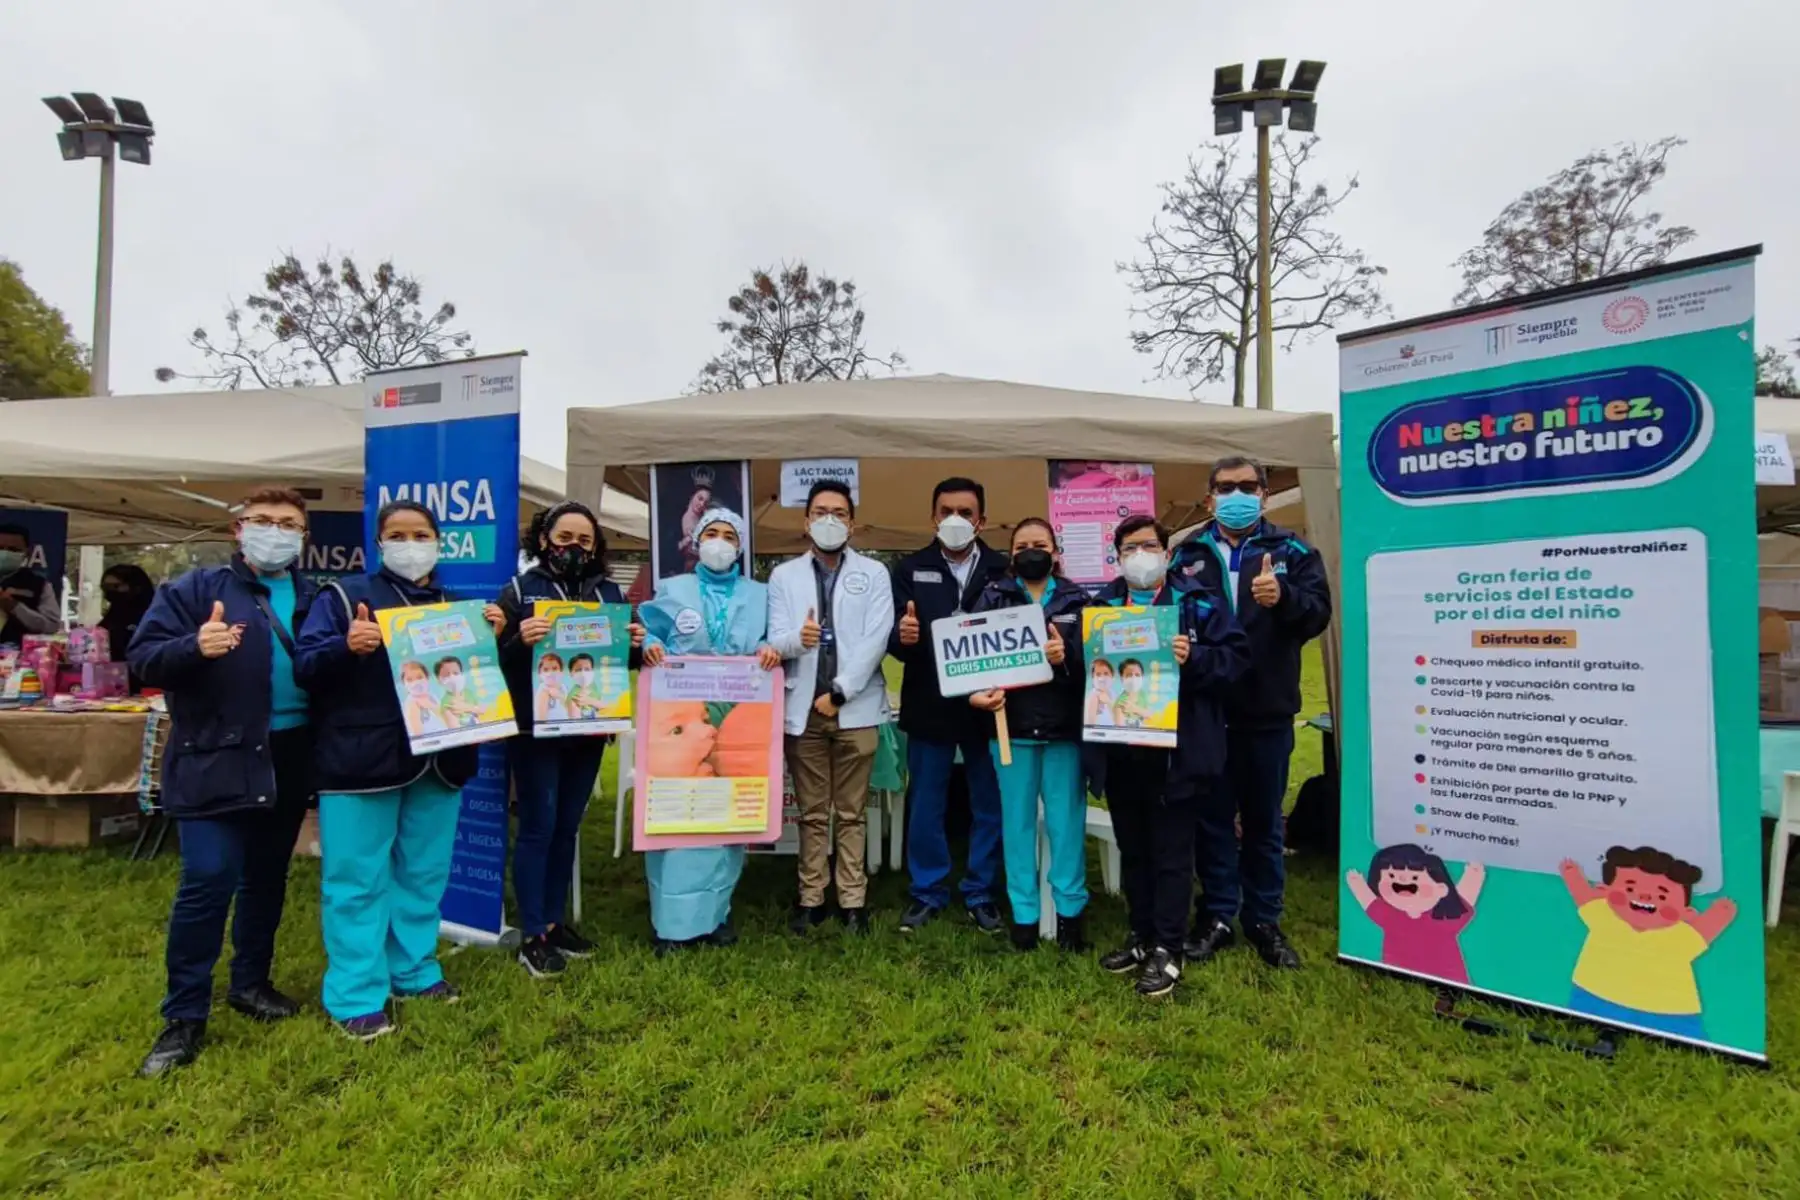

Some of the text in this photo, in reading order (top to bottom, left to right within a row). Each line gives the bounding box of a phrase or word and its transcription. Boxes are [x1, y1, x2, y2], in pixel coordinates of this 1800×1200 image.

[1517, 316, 1578, 335] Siempre
[1539, 328, 1577, 344] pueblo
[1364, 363, 1408, 377] Gobierno
[1411, 357, 1428, 367] del
[1399, 395, 1664, 448] Nuestra niñez,
[1399, 426, 1663, 475] nuestro futuro
[794, 467, 855, 476] LACTANCIA
[1542, 541, 1688, 557] #PorNuestraNiñez
[1457, 566, 1592, 584] Gran feria de
[1424, 584, 1634, 602] servicios del Estado
[1435, 609, 1468, 624] por
[1472, 607, 1488, 620] el
[1531, 605, 1563, 619] del
[1569, 604, 1621, 619] niño
[942, 625, 1040, 660] MINSA
[1480, 633, 1567, 645] Disfruta de:
[948, 652, 1041, 676] DIRIS LIMA SUR
[1431, 657, 1644, 672] Chequeo médico infantil gratuito.
[1431, 676, 1635, 692] Descarte y vacunación contra la
[1431, 688, 1554, 701] Covid-19 para niños.
[1431, 707, 1628, 726] Evaluación nutricional y ocular.
[1430, 726, 1609, 747] Vacunación según esquema
[1431, 738, 1637, 762] regular para menores de 5 años.
[1432, 757, 1637, 784] Trámite de DNI amarillo gratuito.
[1431, 776, 1627, 807] Exhibición por parte de la PNP y
[1431, 788, 1557, 809] las fuerzas armadas.
[1431, 806, 1462, 818] Show
[1465, 811, 1480, 821] de
[1444, 829, 1486, 841] mucho
[1488, 835, 1520, 847] más!
